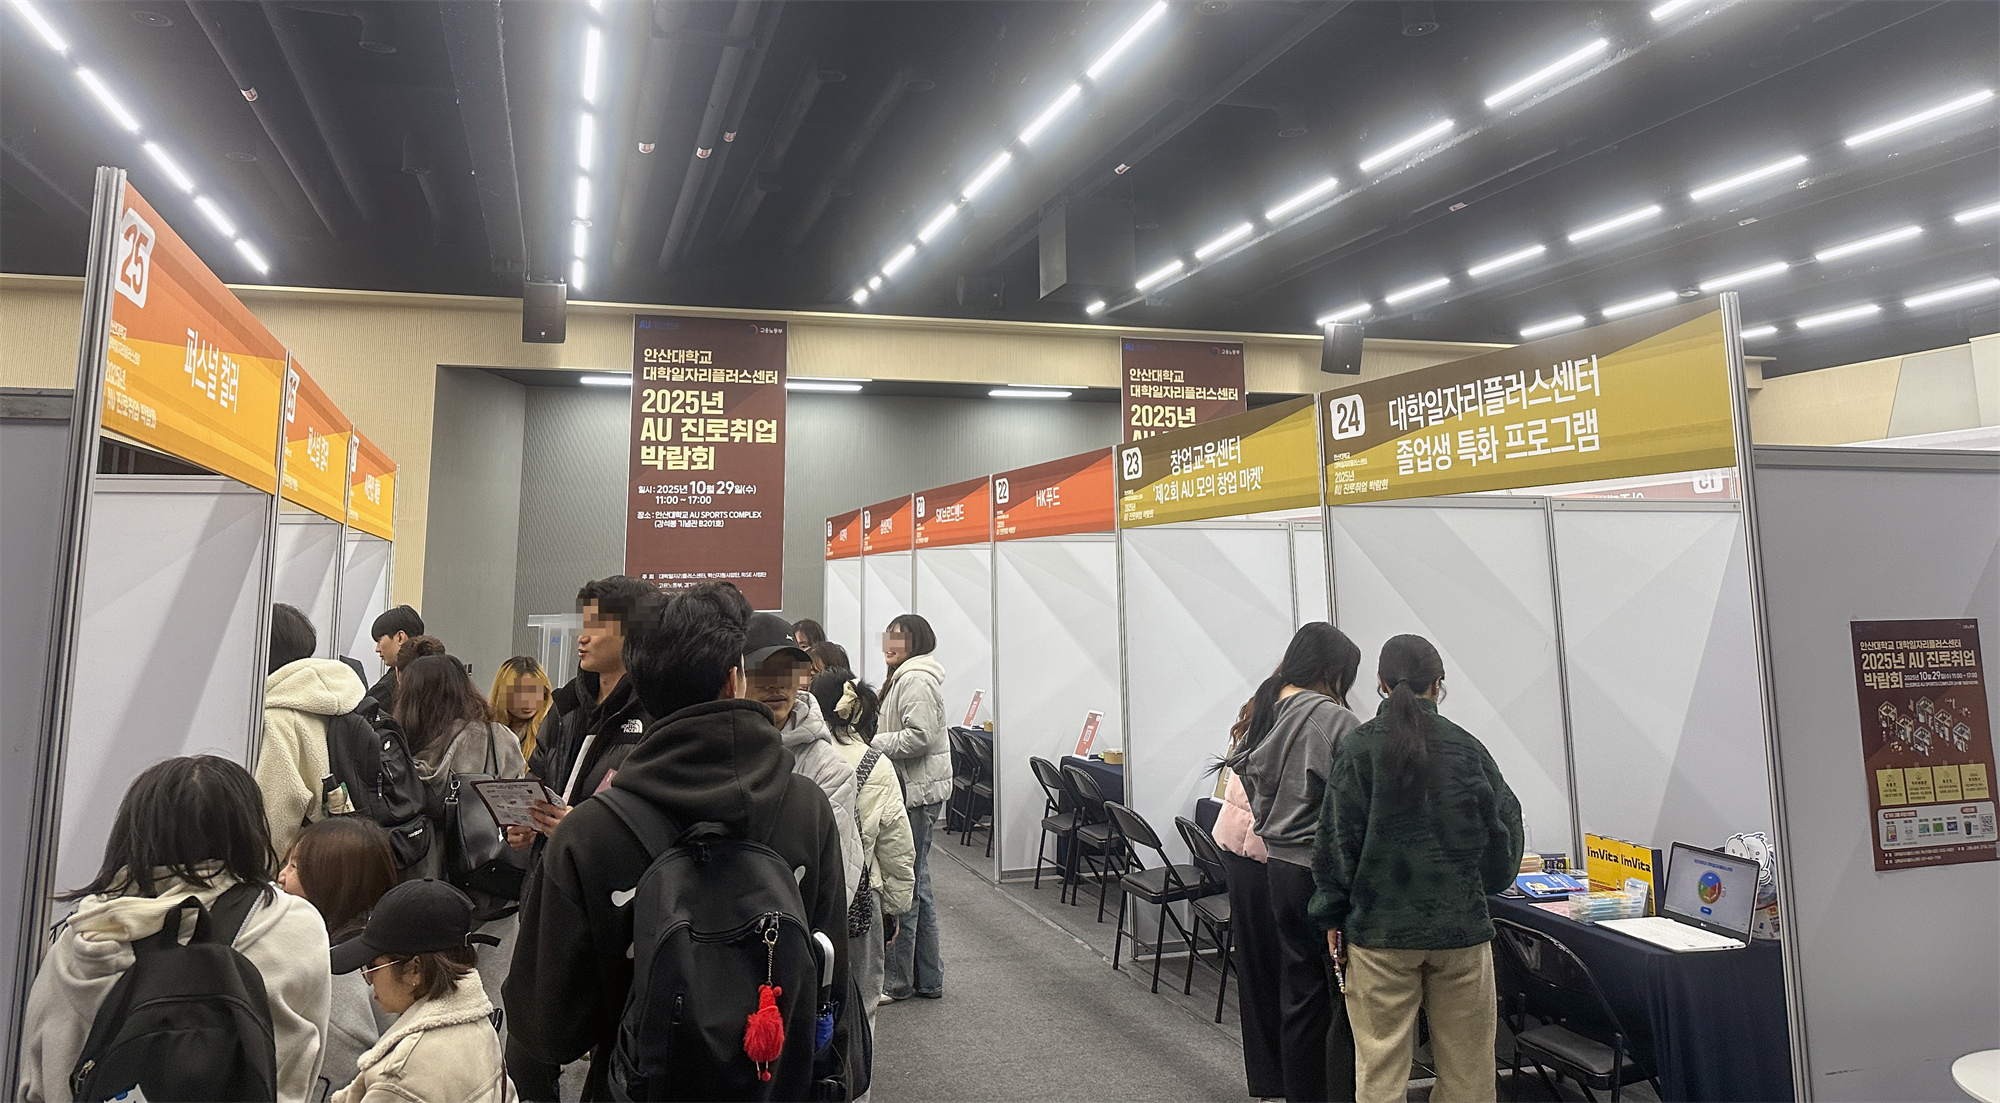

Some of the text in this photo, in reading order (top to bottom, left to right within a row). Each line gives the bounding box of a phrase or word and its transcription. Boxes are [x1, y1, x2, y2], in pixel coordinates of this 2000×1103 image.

[121, 224, 148, 294] 25
[644, 348, 712, 364] 안산대학교
[184, 327, 239, 413] 퍼스널 컬러
[643, 367, 778, 384] 대학일자리플러스센터
[1130, 368, 1184, 382] 안산대학교
[642, 389, 724, 414] 2025년
[1130, 385, 1238, 400] 대학일자리플러스센터
[1388, 354, 1600, 430] 대학일자리플러스센터
[1131, 404, 1196, 428] 2025년
[1337, 401, 1360, 434] 24
[640, 418, 777, 443] AU 진로취업
[1397, 408, 1600, 476] 졸업생 특화 프로그램
[641, 446, 714, 470] 박람회
[1126, 452, 1139, 476] 23
[1170, 436, 1241, 476] 창업교육센터
[657, 485, 688, 494] 2025년
[690, 481, 714, 494] 10월
[716, 481, 756, 494] 29일(수)
[998, 481, 1007, 500] 22
[1181, 479, 1194, 498] AU
[1196, 474, 1215, 497] 모의
[1217, 470, 1237, 496] 창업
[655, 496, 678, 504] 11:00
[688, 496, 712, 504] 17:00
[1036, 487, 1060, 508] HK푸드
[1860, 639, 1962, 650] 안산대학교 대학일자리플러스센터
[1862, 650, 1976, 670] 2025년 AU 진로취업
[1864, 672, 1904, 690] 박람회
